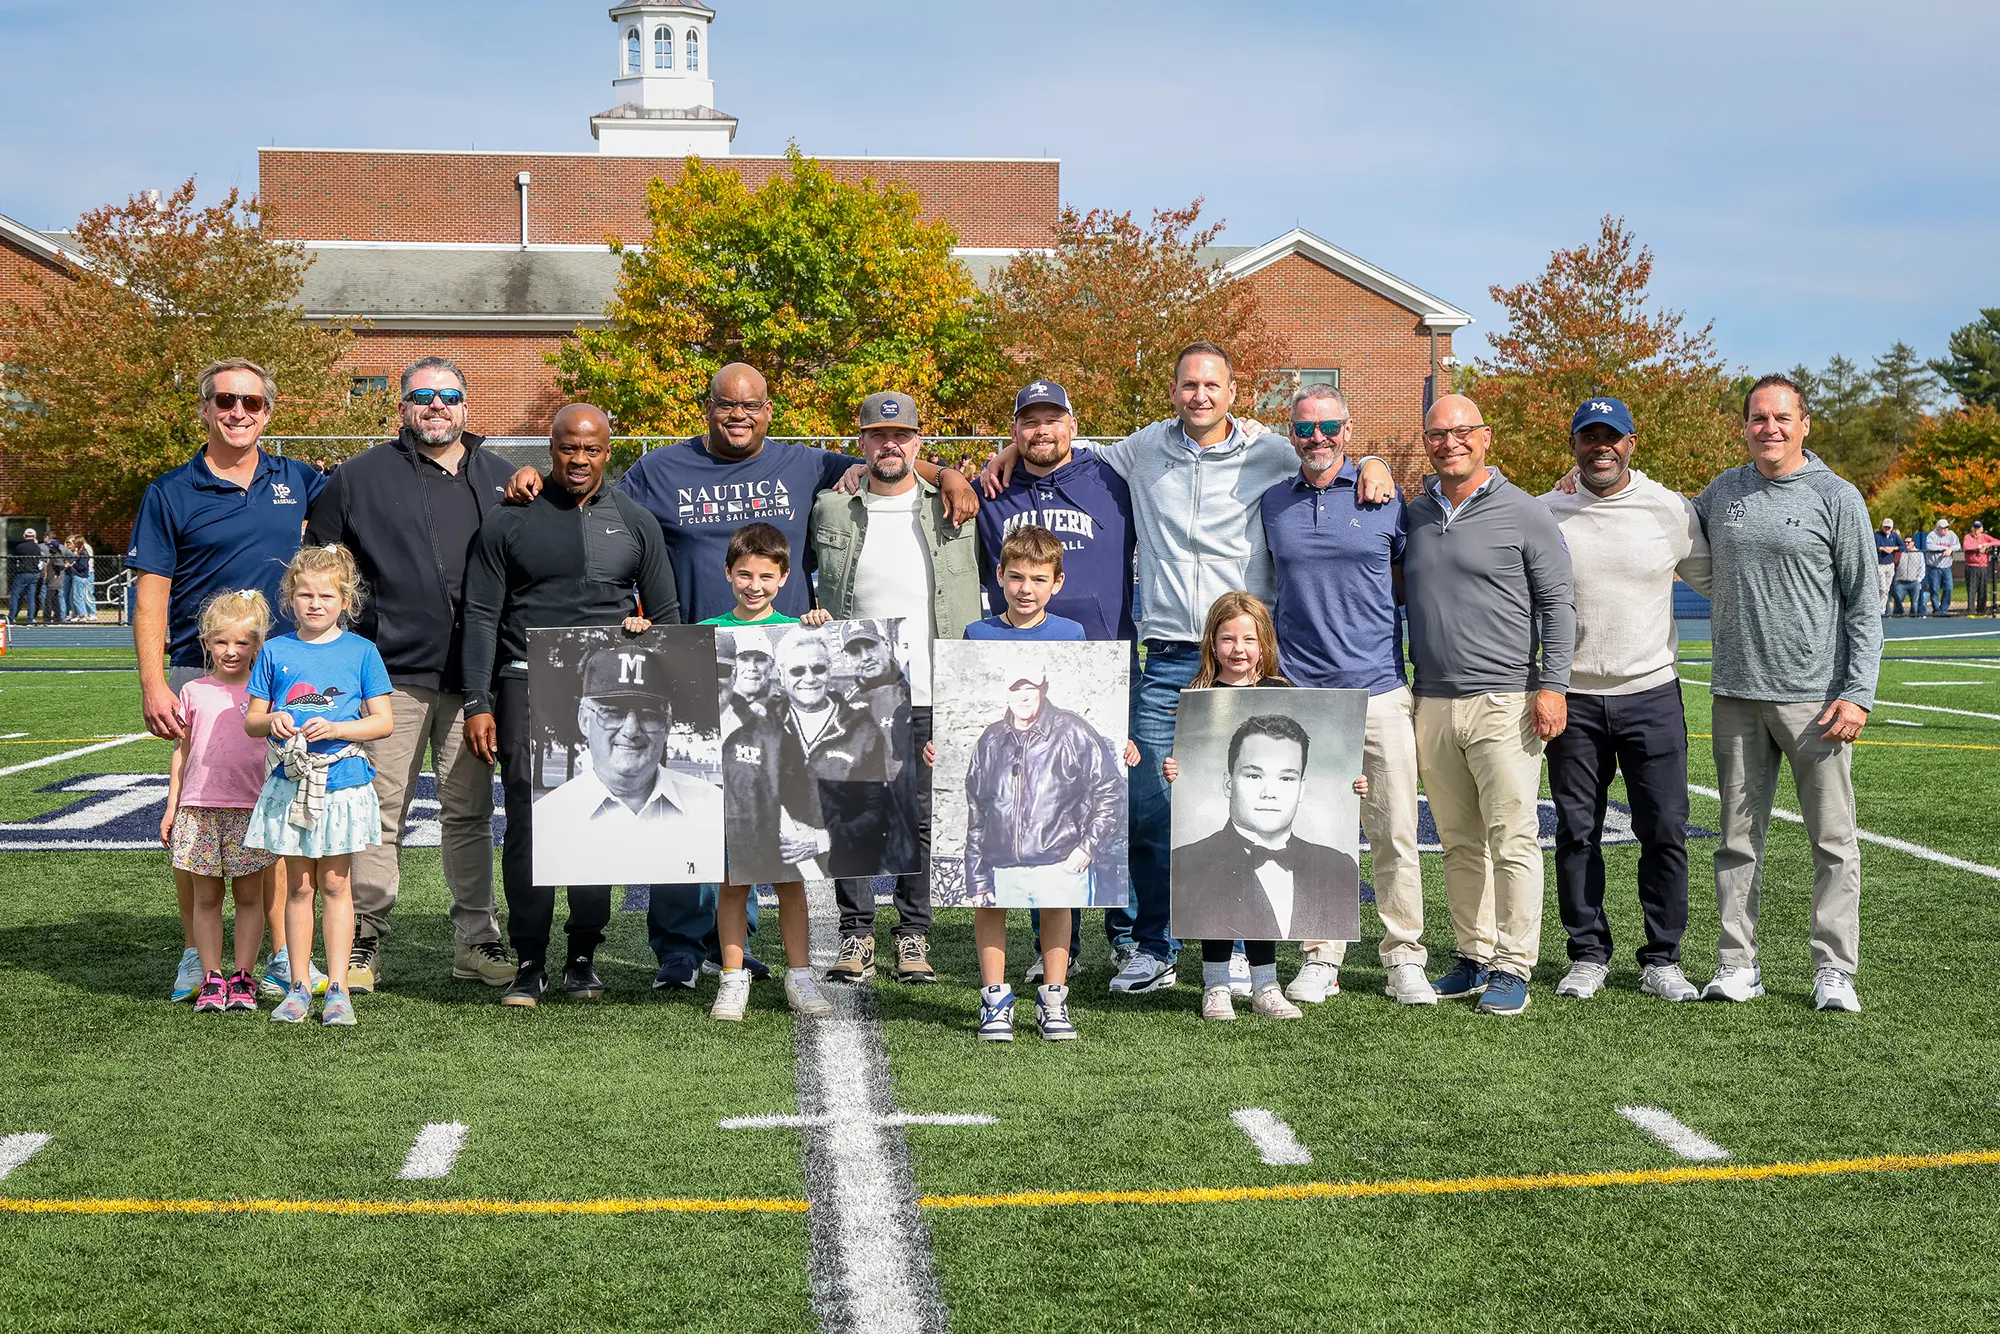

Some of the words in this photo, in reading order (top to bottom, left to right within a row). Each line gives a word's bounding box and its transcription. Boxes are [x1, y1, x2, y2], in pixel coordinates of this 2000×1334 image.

[1590, 401, 1613, 414] MP
[270, 482, 291, 499] MP
[677, 479, 789, 505] NAUTICA
[688, 515, 721, 524] CLASS
[726, 512, 750, 522] SAIL
[754, 508, 791, 518] RACING
[1727, 501, 1747, 522] MP
[618, 653, 646, 685] M
